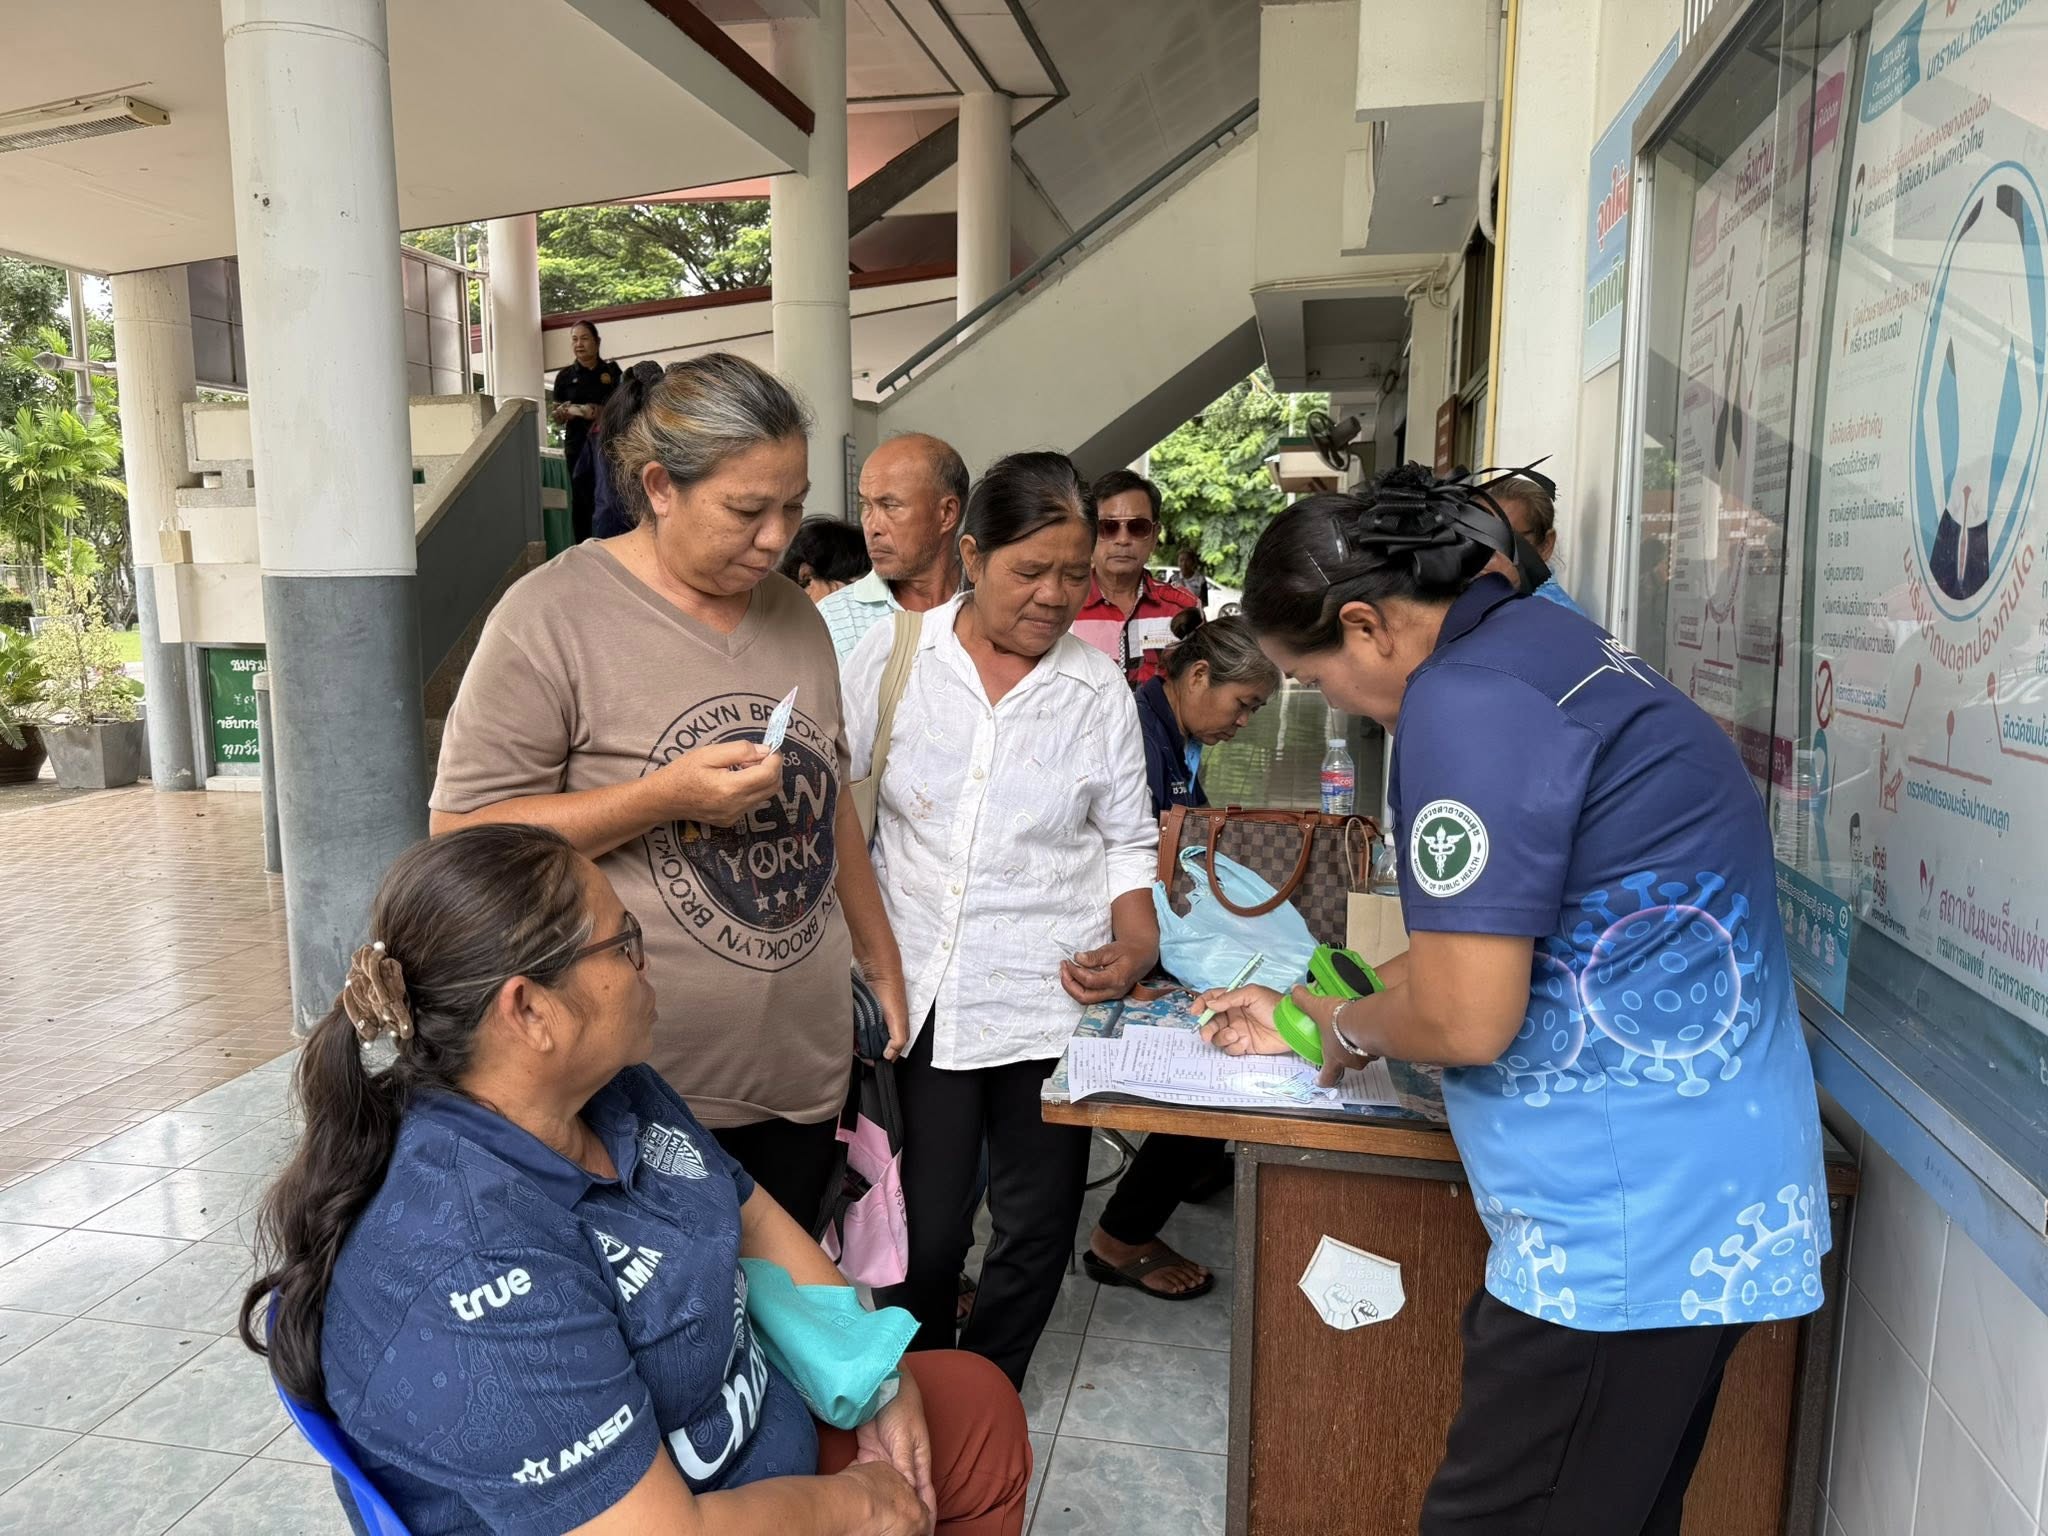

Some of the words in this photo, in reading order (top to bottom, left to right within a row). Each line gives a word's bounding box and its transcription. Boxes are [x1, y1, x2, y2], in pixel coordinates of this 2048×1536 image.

[718, 831, 823, 883] YORK
[1460, 856, 1481, 883] HEALTH
[1940, 885, 2048, 974] สถาบันมะเร็งแห่ง
[450, 1267, 533, 1322] true
